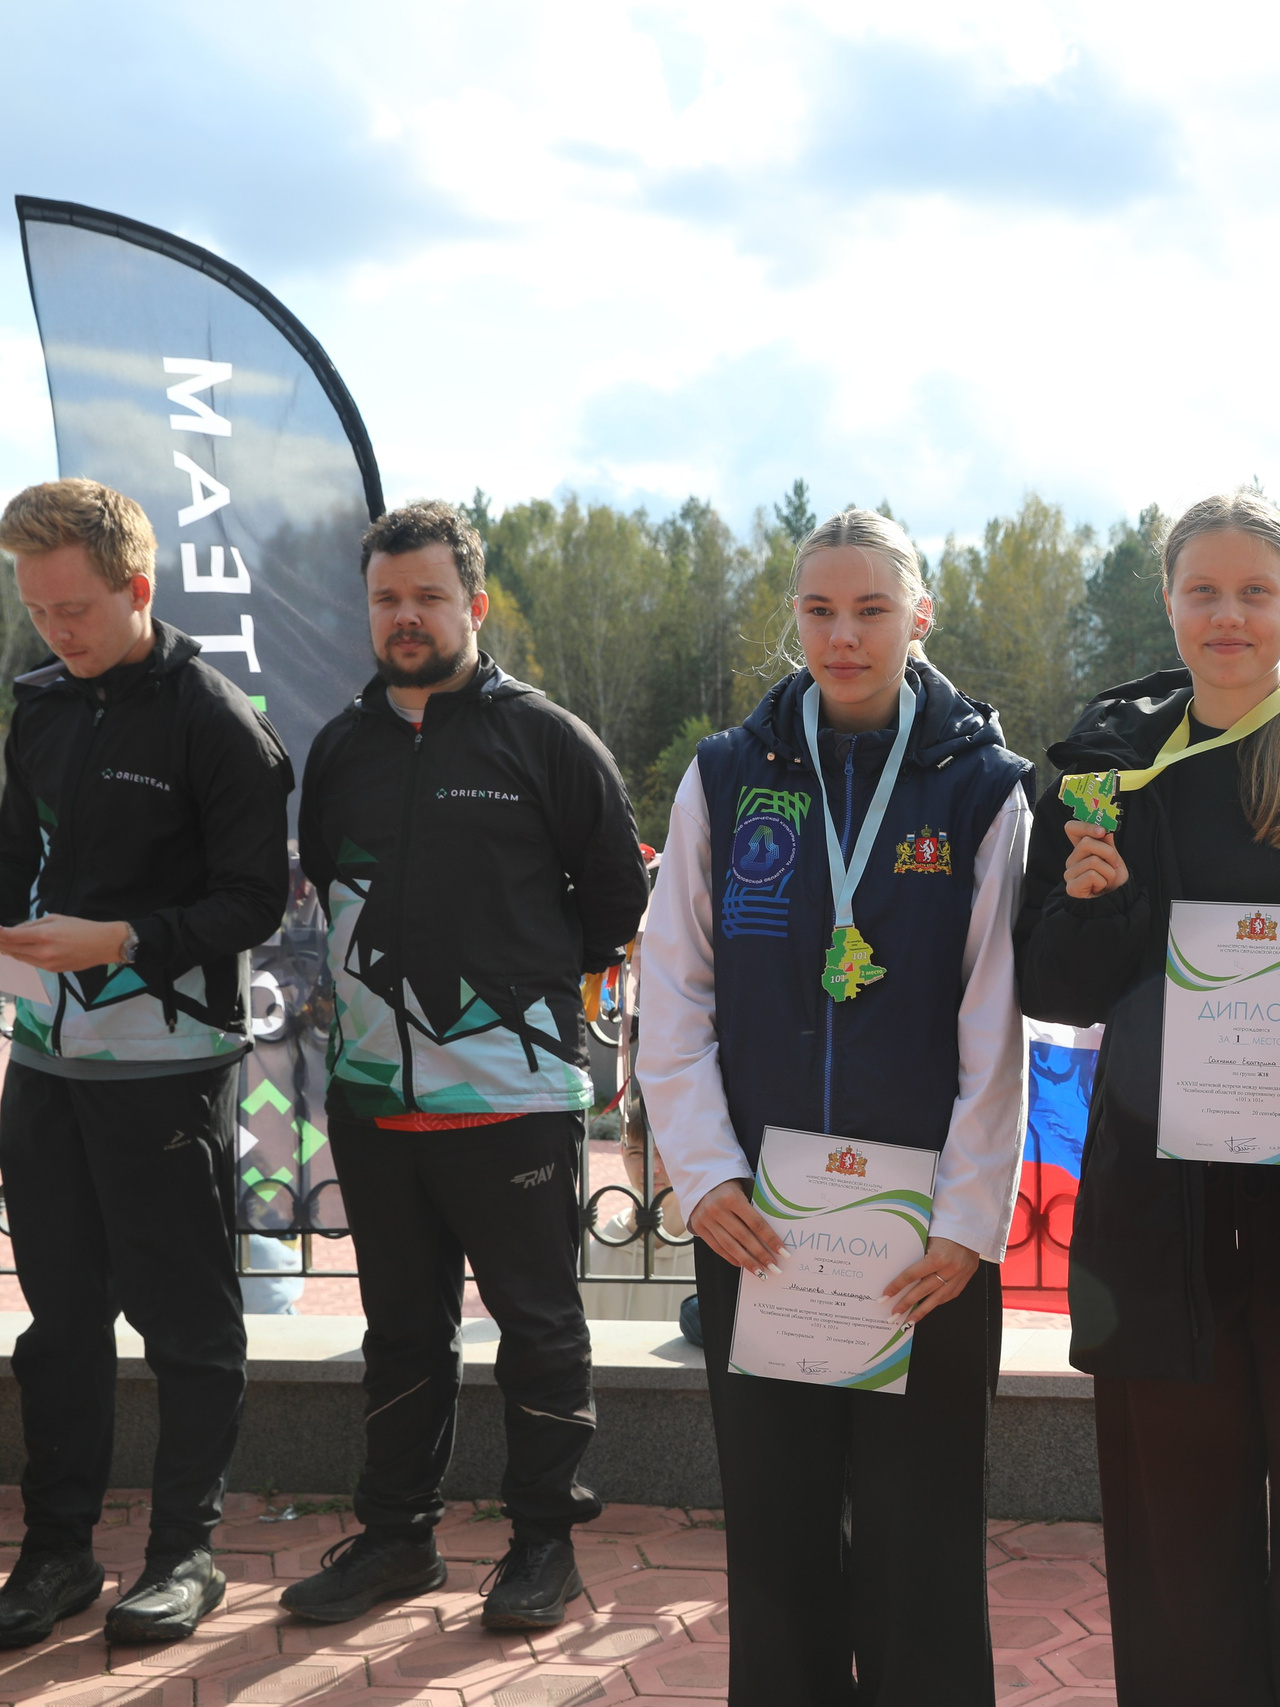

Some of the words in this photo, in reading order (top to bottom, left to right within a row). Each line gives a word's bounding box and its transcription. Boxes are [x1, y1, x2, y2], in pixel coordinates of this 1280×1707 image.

[450, 789, 519, 801] ORIENTEAM
[852, 951, 868, 960] 101
[1219, 1035, 1230, 1043] ЗА
[1236, 1034, 1240, 1043] 1
[783, 1229, 887, 1259] ДИПЛОМ
[814, 1257, 851, 1265] награждается
[799, 1263, 810, 1272] ЗА
[818, 1264, 824, 1273] 2
[832, 1268, 863, 1279] МЕСТО
